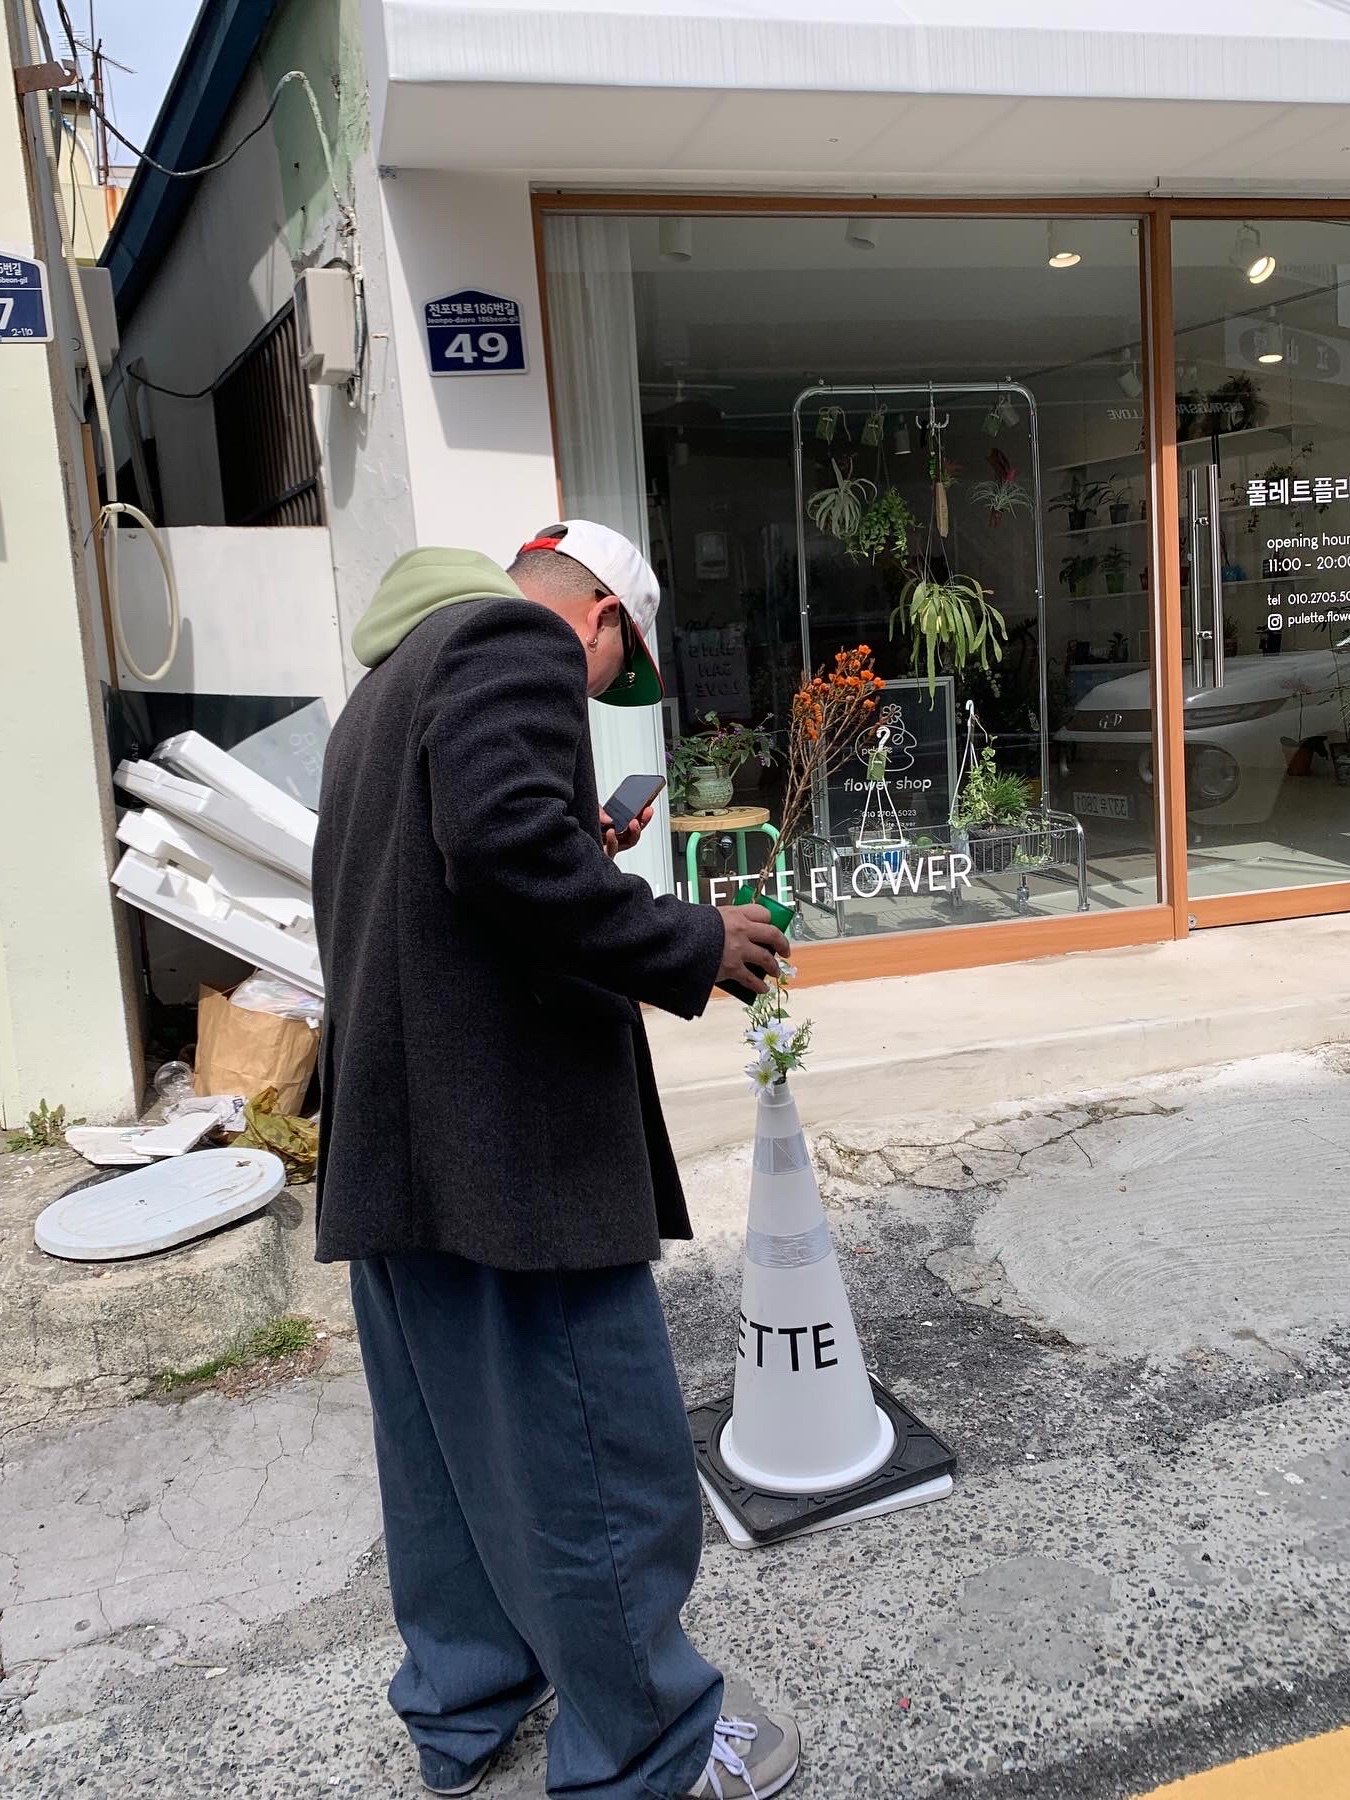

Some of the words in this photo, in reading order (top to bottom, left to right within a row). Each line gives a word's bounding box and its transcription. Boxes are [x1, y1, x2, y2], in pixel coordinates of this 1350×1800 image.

[428, 302, 516, 317] 전포대로186번길
[444, 332, 509, 364] 49
[1266, 533, 1319, 552] opening
[1268, 557, 1302, 573] 11:00
[1267, 593, 1281, 606] tel
[843, 778, 892, 792] flower
[896, 776, 932, 793] shop
[897, 809, 917, 817] 5023
[810, 853, 973, 904] FLOWER
